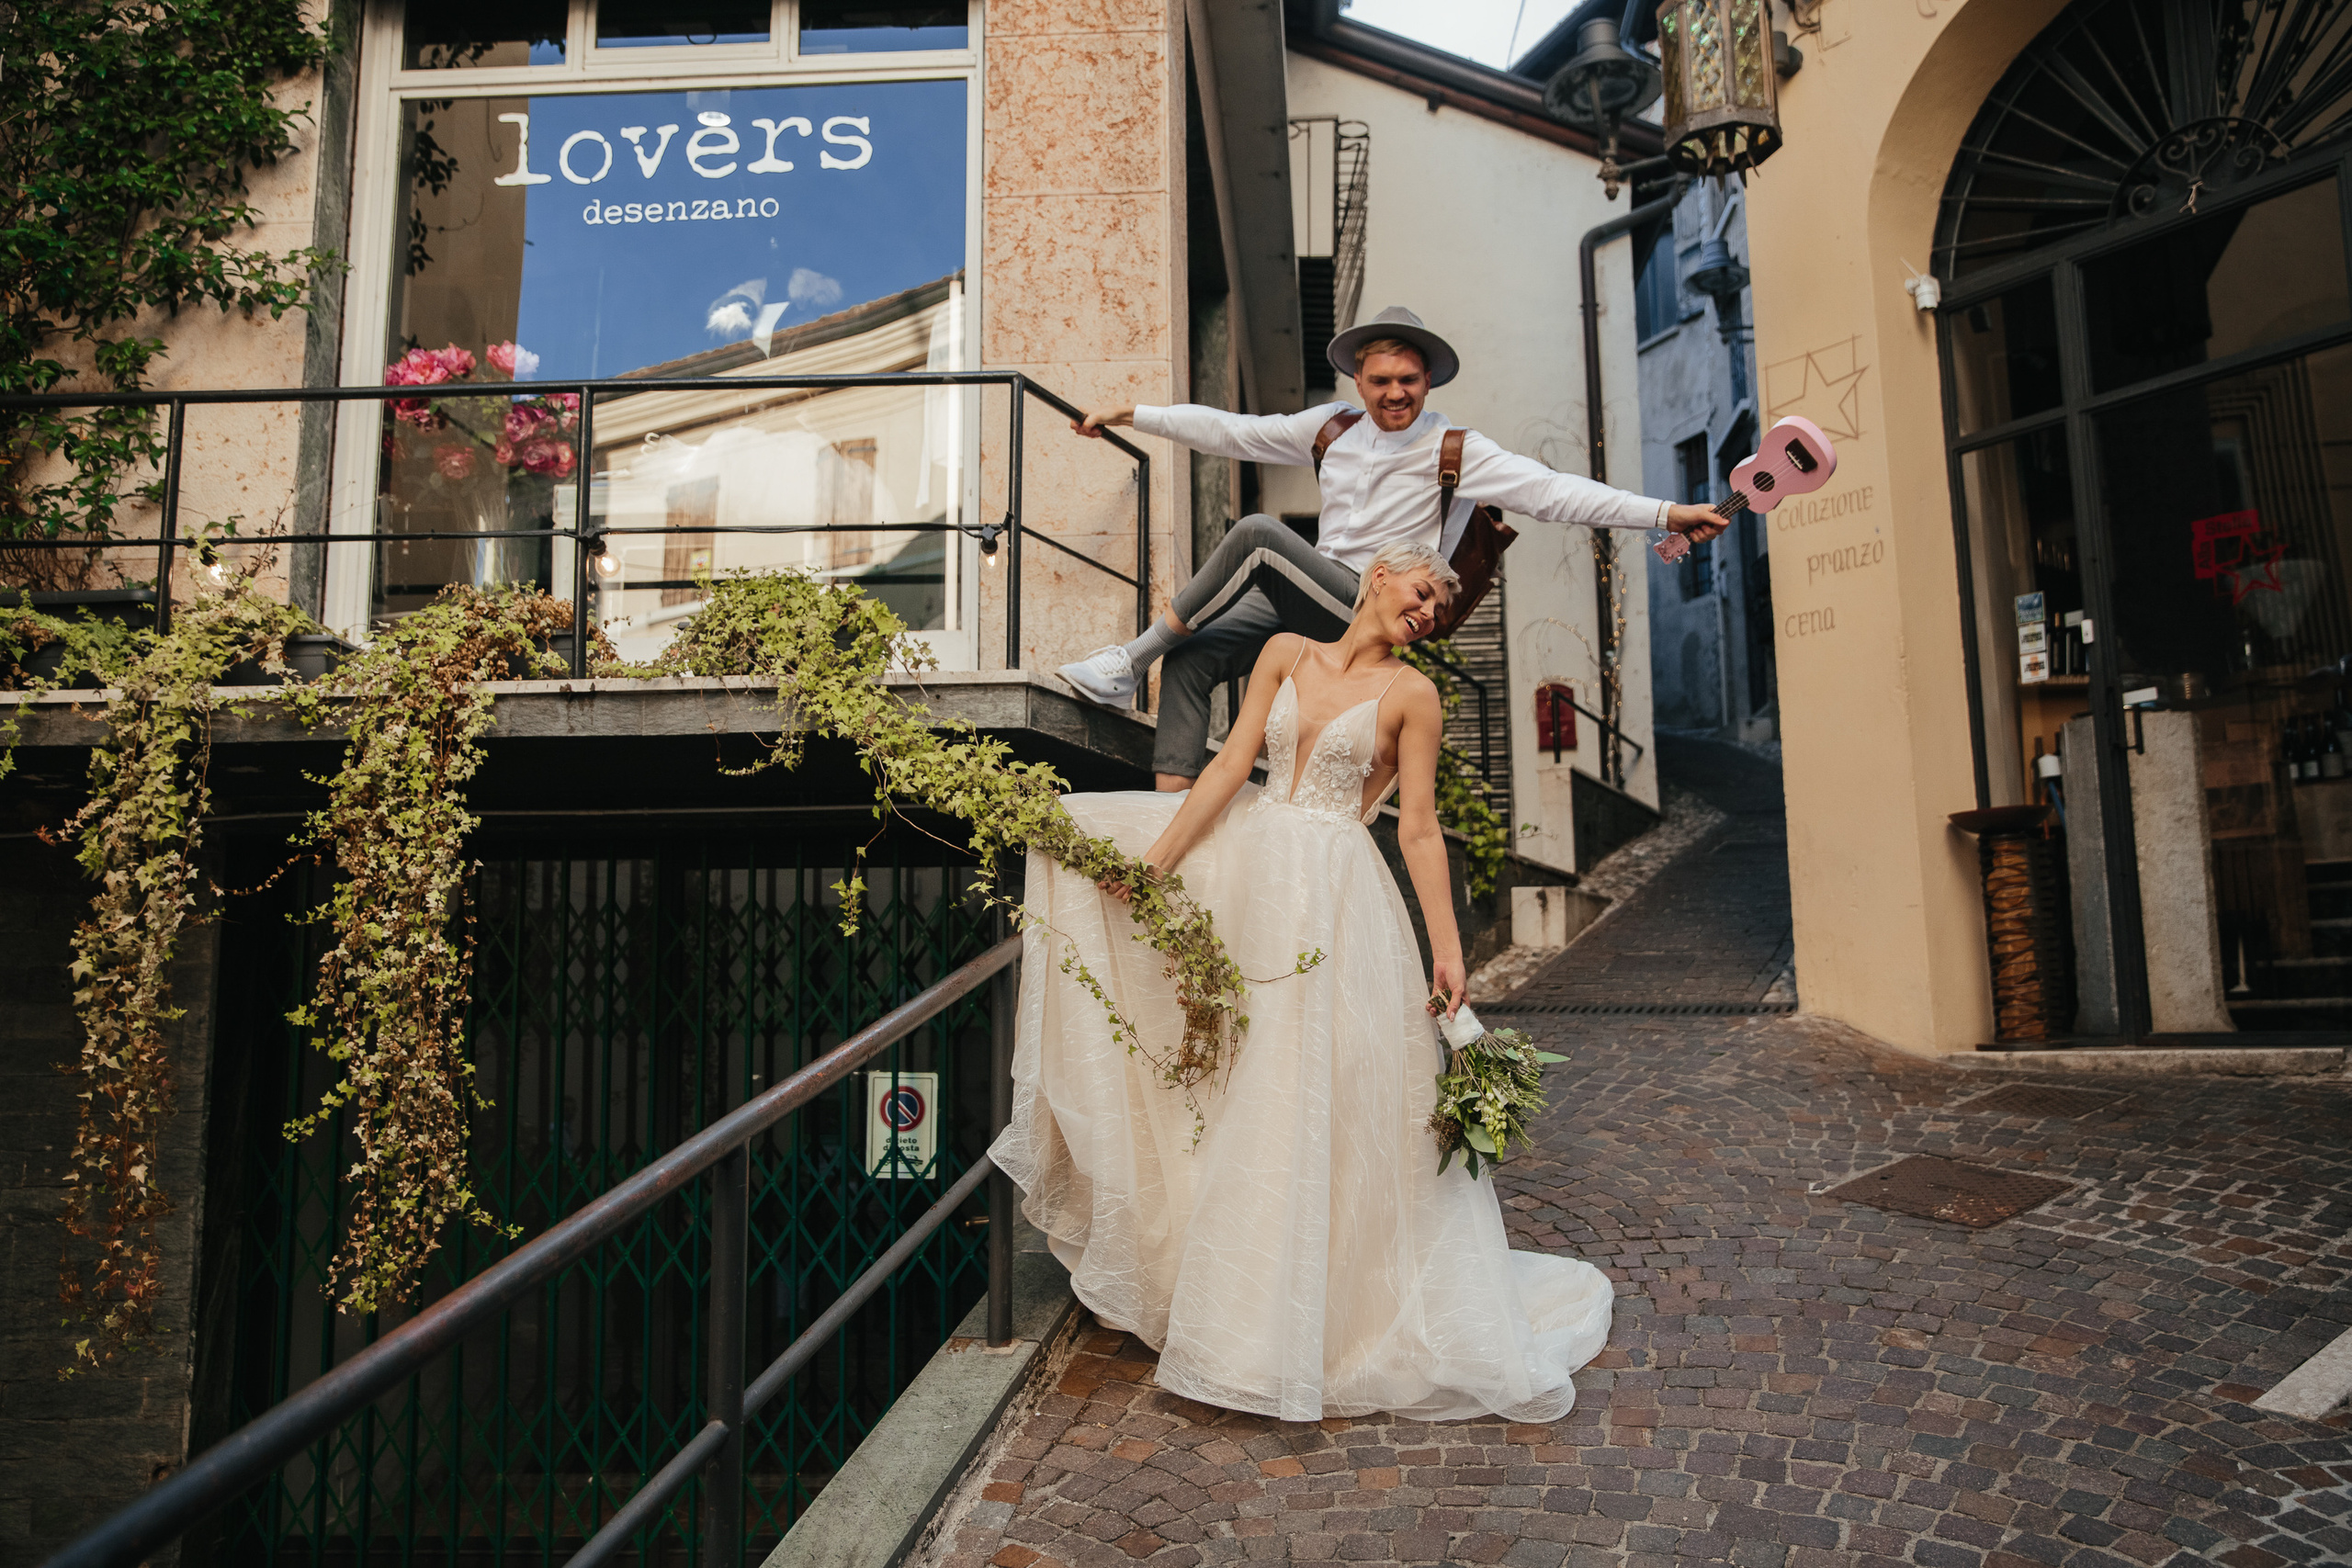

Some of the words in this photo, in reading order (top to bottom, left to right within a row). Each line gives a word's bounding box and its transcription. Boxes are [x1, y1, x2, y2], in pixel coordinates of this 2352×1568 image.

[494, 112, 873, 186] lovers
[582, 197, 780, 225] desenzano
[1777, 485, 1874, 532] colazione
[1806, 539, 1883, 587] pranzo
